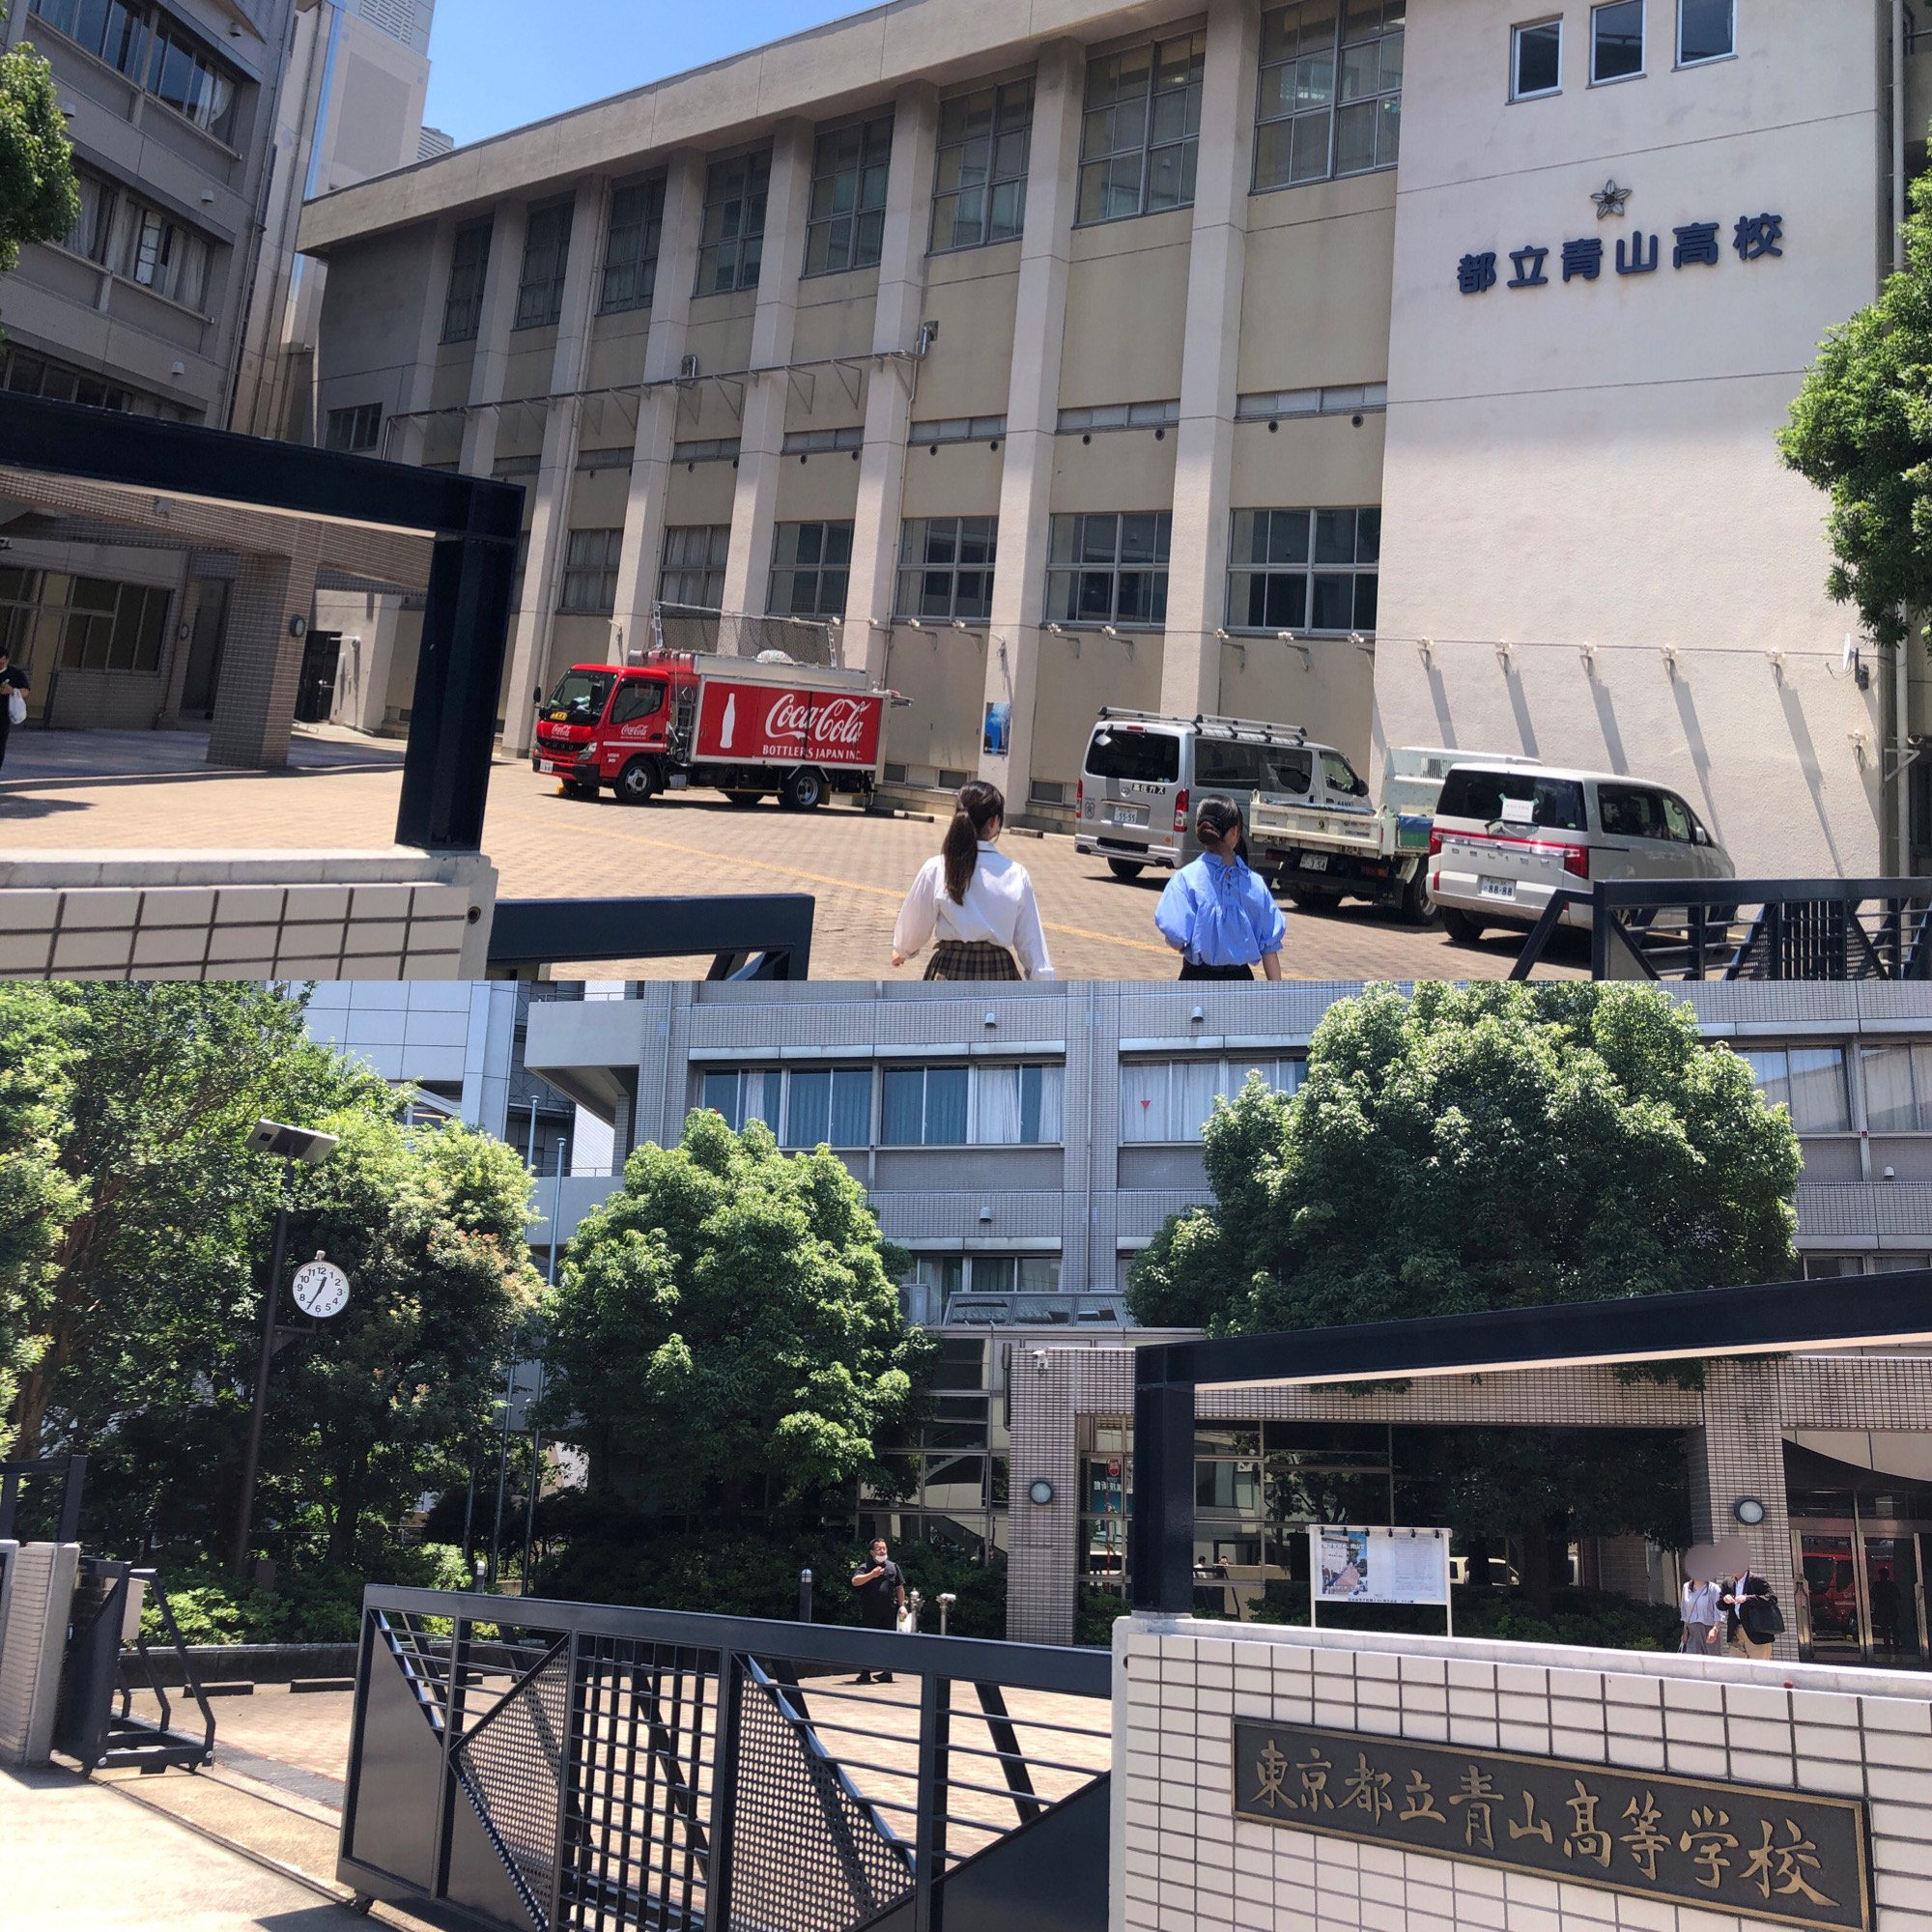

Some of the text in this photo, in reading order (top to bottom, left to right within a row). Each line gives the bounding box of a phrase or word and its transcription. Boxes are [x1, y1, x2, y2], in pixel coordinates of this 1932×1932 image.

[1457, 213, 1782, 294] 都立青山高校
[765, 694, 871, 744] Coca-Cola
[621, 724, 648, 736] Coca-Cola
[763, 745, 813, 758] BOTTLERS
[815, 748, 843, 760] JAPAN
[1132, 783, 1165, 795] 高圧ガス
[1488, 884, 1513, 896] 88-88
